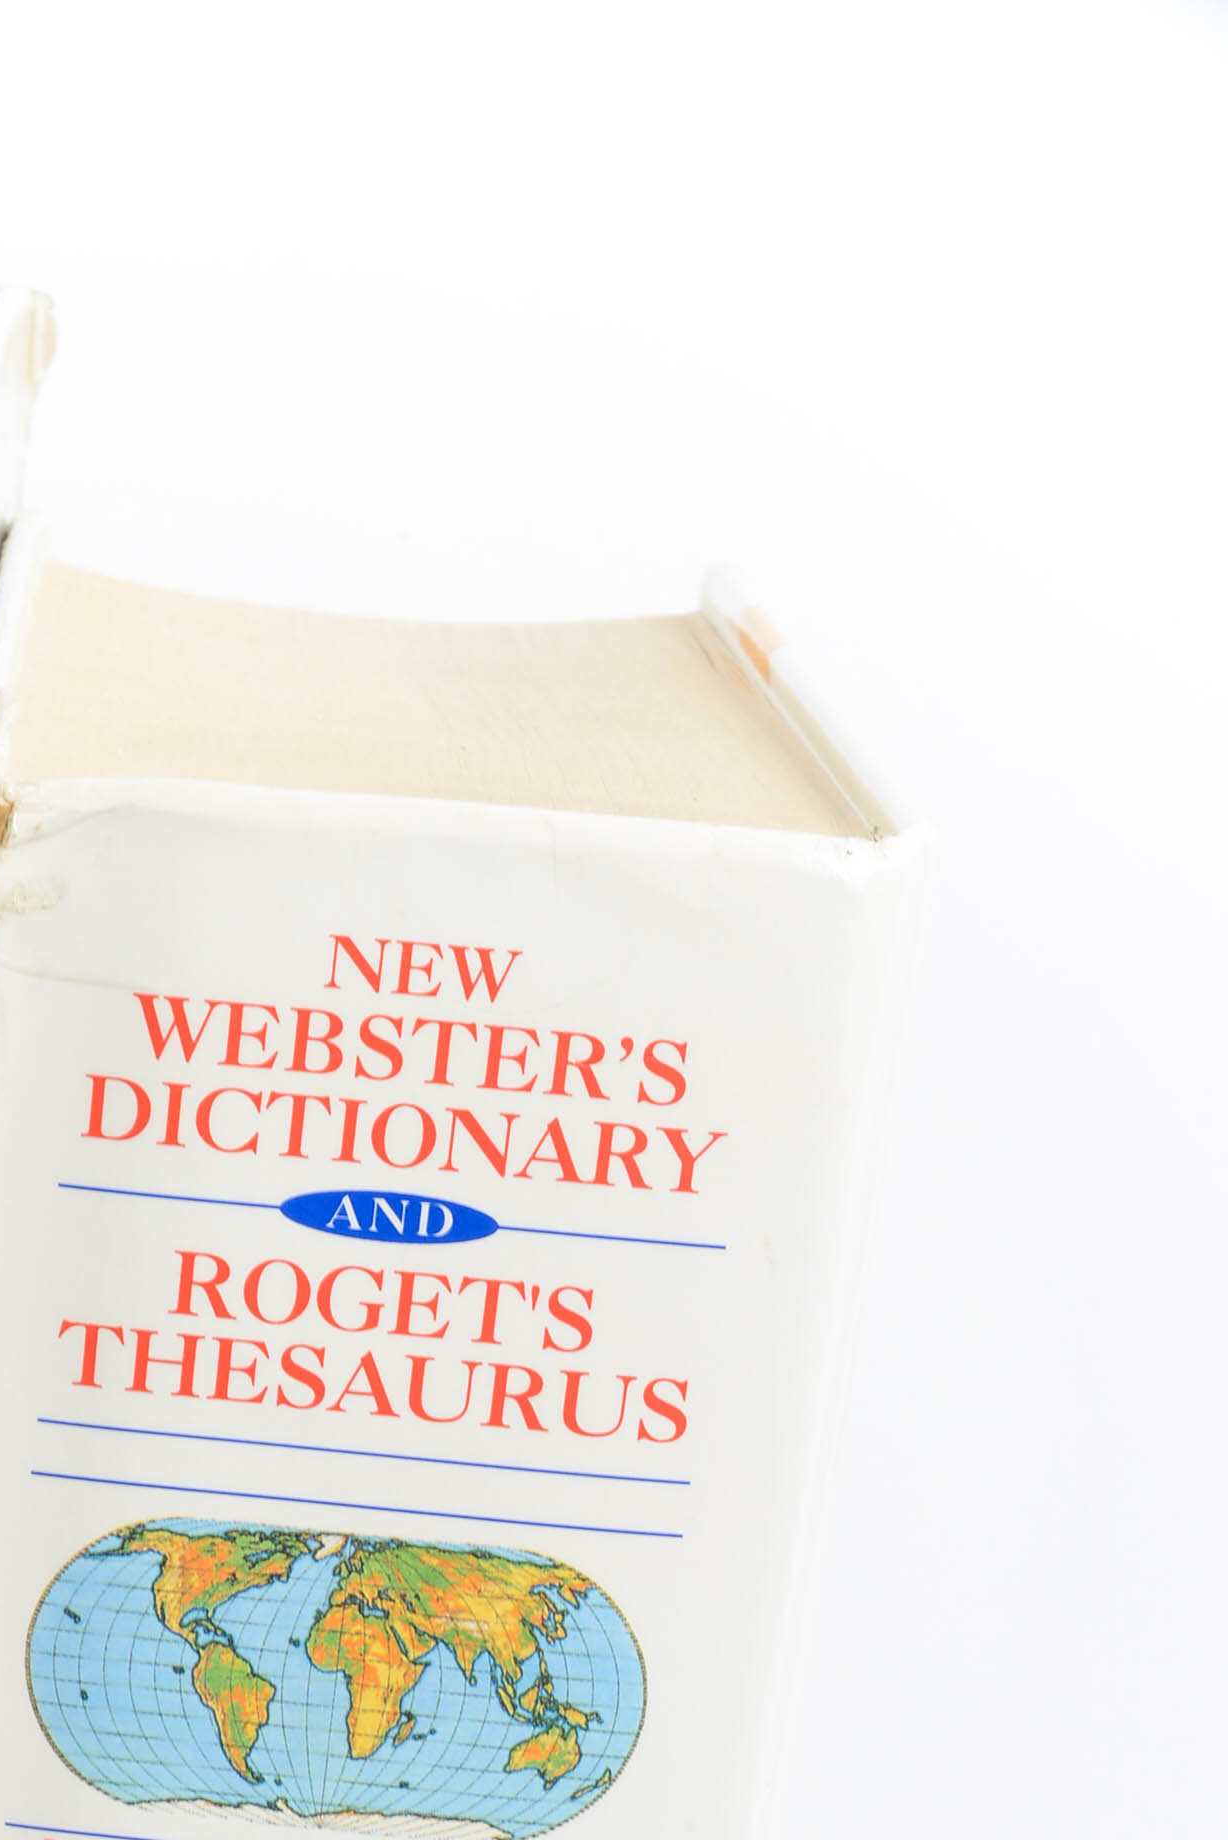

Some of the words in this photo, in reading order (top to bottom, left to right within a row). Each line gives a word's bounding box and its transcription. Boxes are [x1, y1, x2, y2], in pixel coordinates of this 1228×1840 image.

[324, 934, 523, 1004] NEW
[133, 992, 689, 1107] WEBSTER'S
[80, 1073, 729, 1194] DICTIONARY
[325, 1194, 454, 1239] AND
[167, 1249, 595, 1353] ROGET'S
[57, 1319, 690, 1444] THESAURUS
